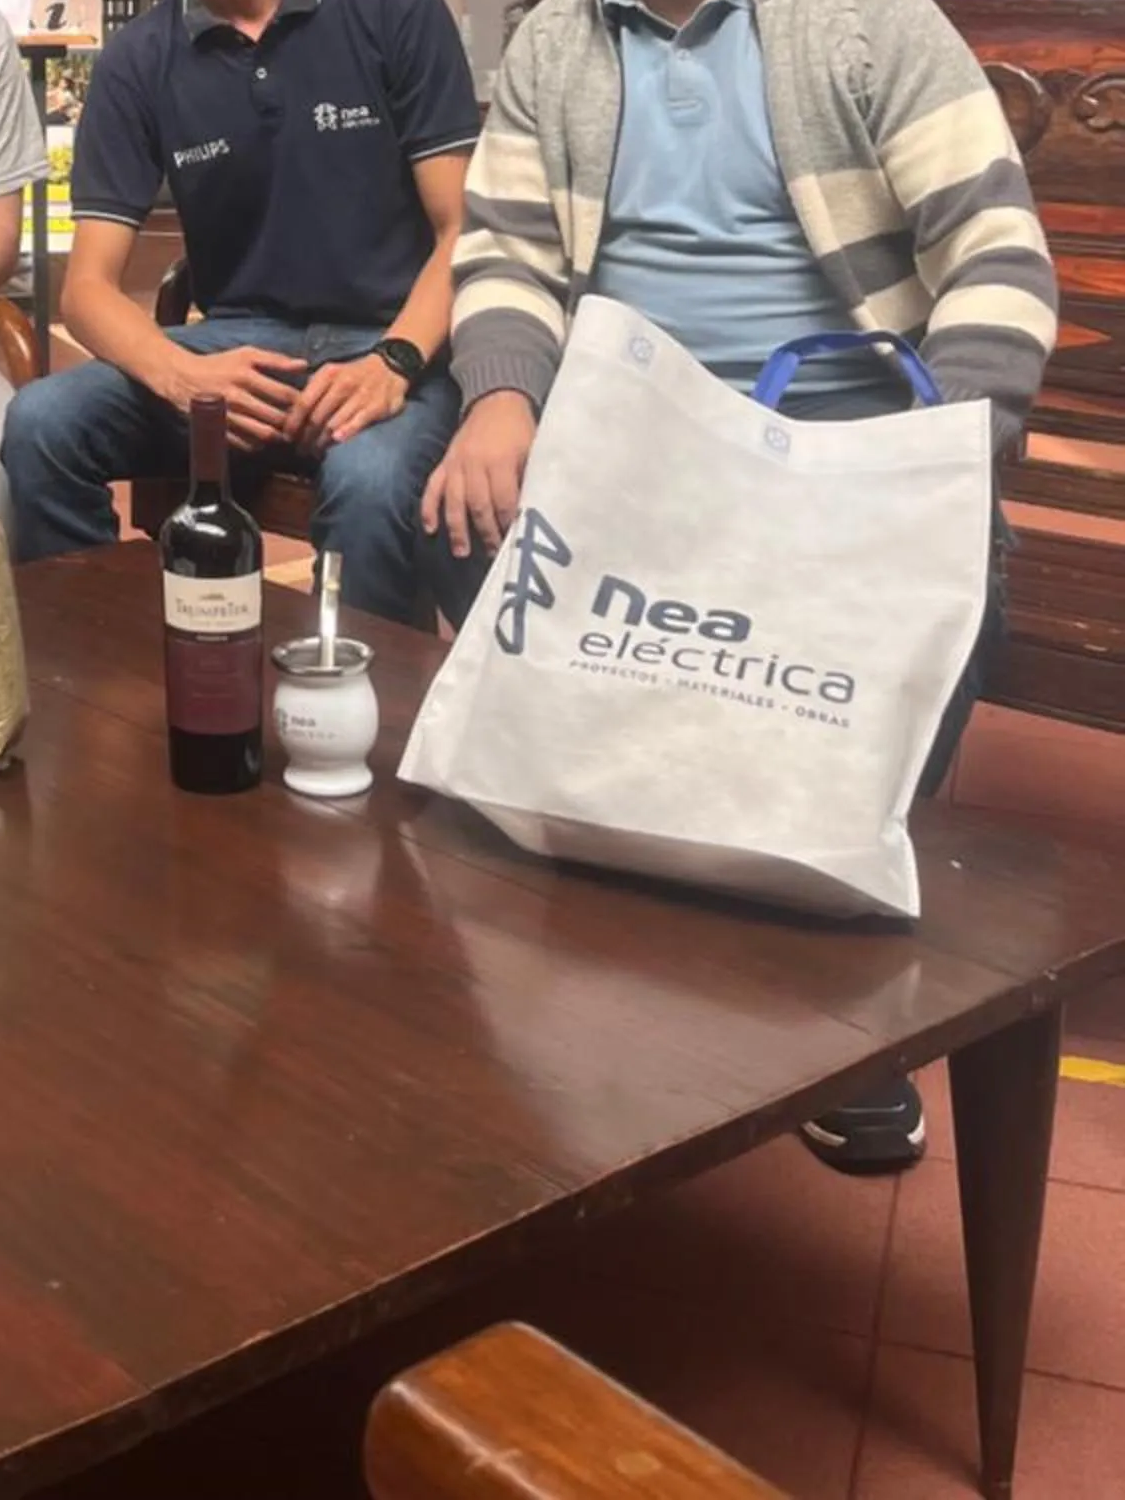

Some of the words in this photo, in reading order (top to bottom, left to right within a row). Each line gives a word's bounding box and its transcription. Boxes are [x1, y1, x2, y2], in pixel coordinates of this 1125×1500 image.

[173, 138, 230, 168] PHILIPS
[591, 574, 752, 643] nea
[568, 658, 659, 685] PROYECTOS
[676, 678, 775, 710] MATERIALES
[794, 705, 851, 729] OBRAS
[578, 628, 857, 705] eléctrica
